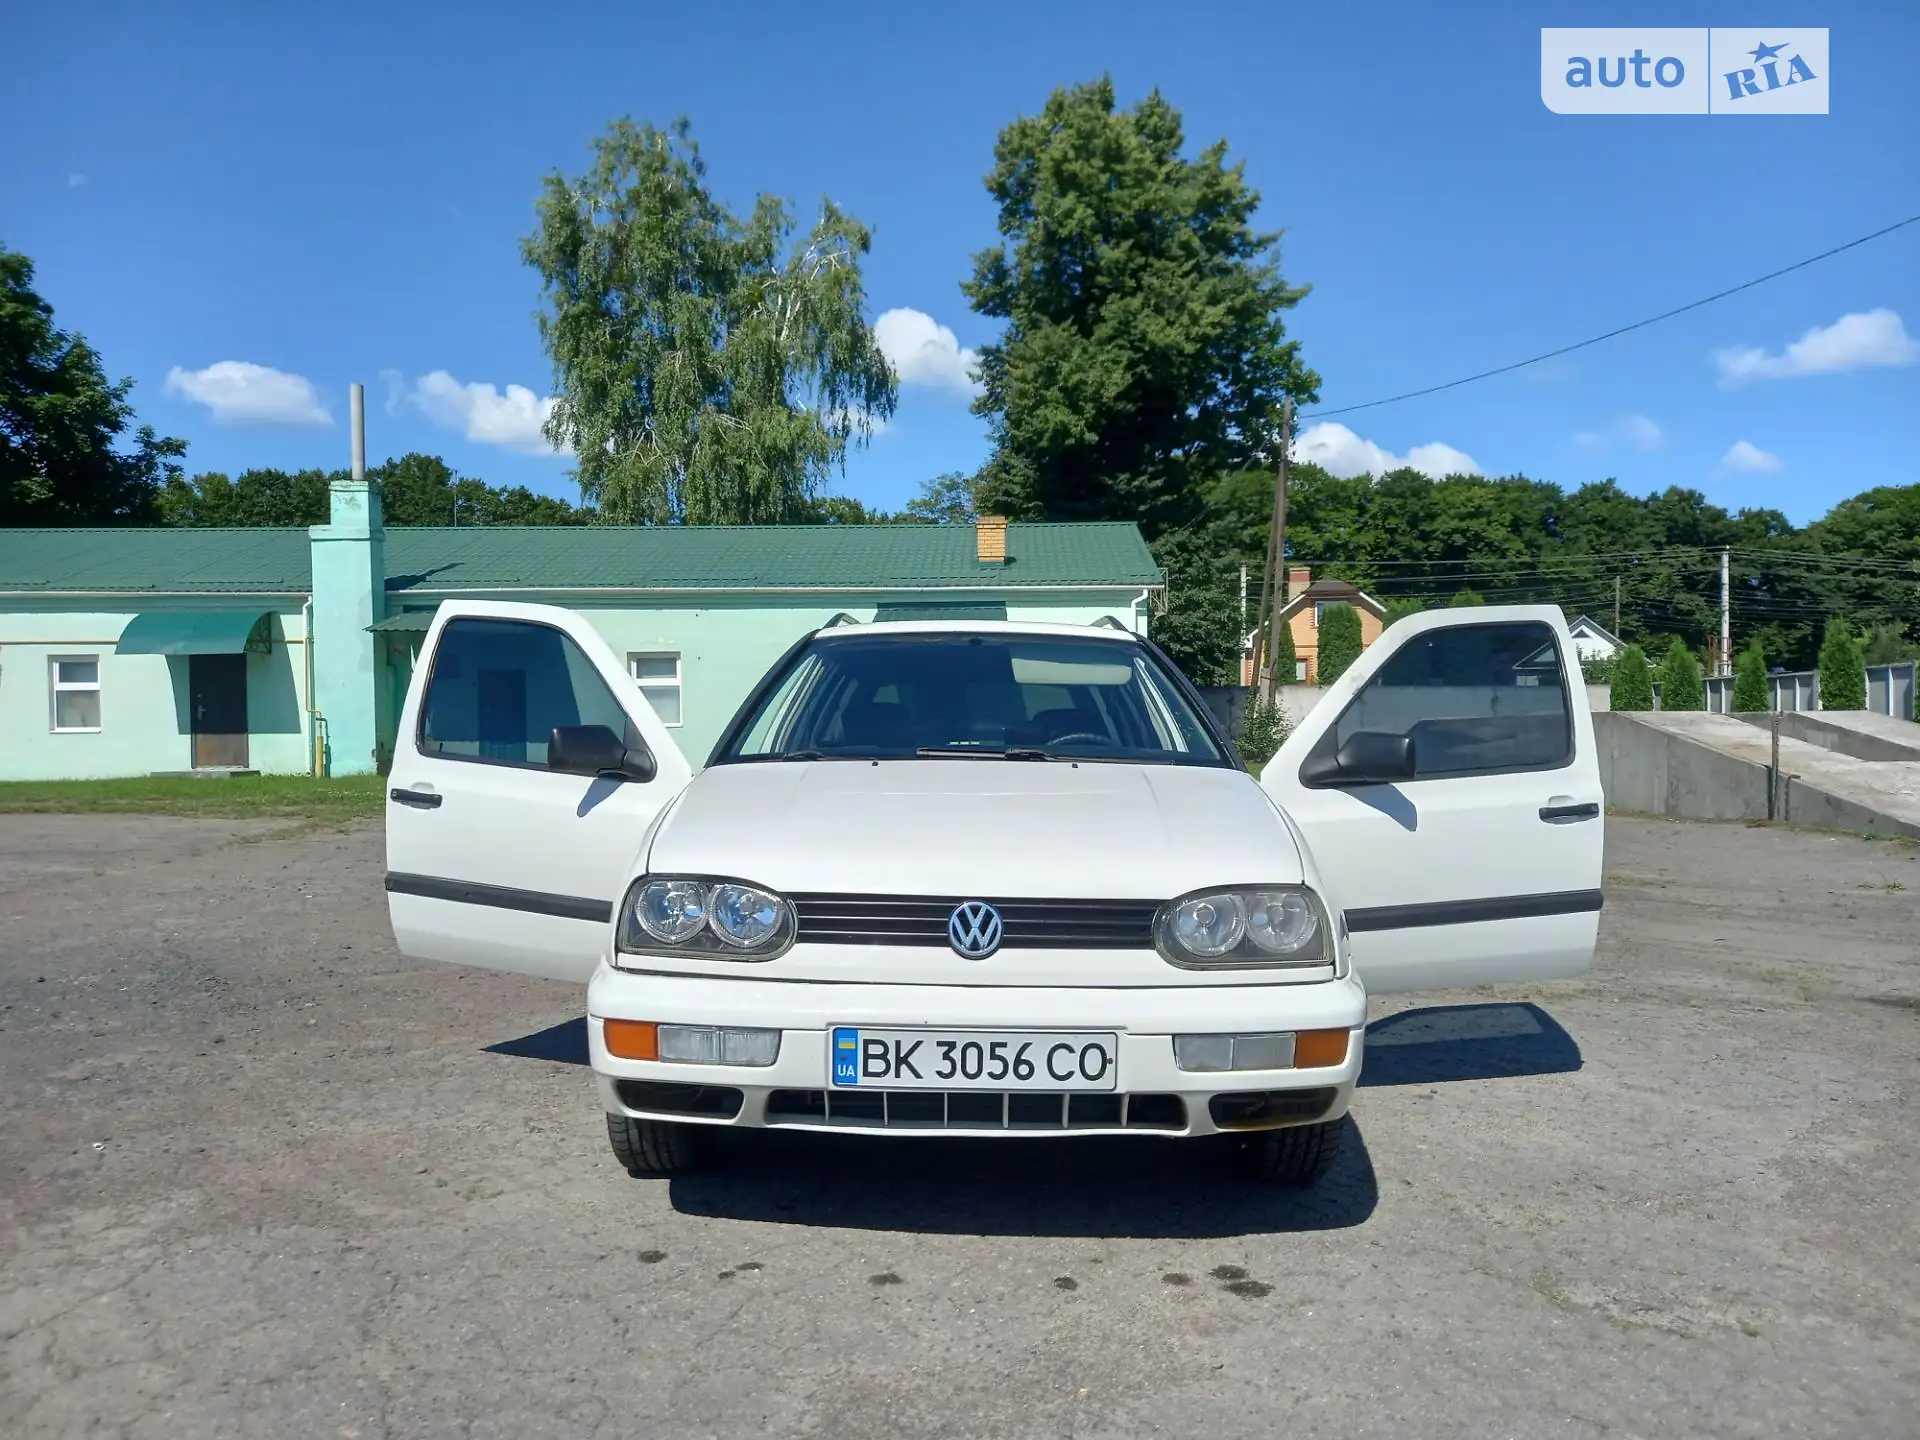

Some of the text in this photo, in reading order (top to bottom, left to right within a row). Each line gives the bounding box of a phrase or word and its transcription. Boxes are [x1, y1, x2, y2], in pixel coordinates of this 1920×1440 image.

[951, 902, 1001, 954] VW
[837, 1064, 856, 1077] UA
[862, 1038, 1108, 1082] BK 3056 CO
